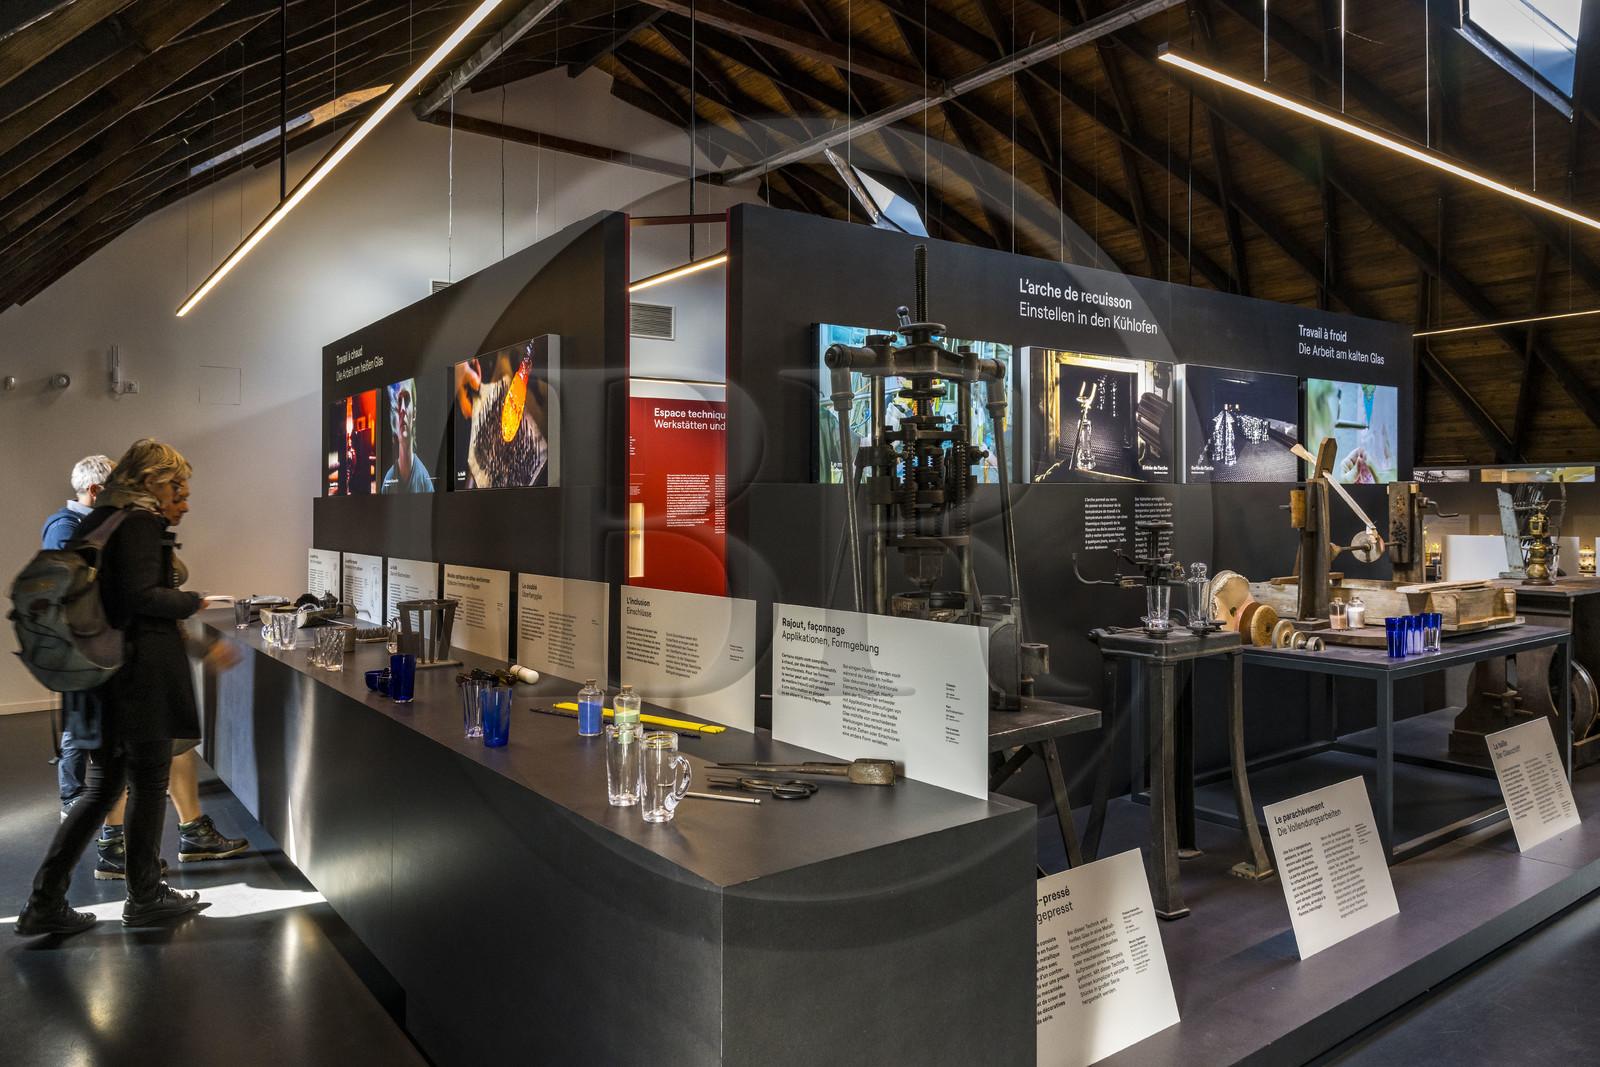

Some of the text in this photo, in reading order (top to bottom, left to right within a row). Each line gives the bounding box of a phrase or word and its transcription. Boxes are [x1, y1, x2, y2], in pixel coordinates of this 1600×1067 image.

[1020, 278, 1132, 310] L'arche de recuisson
[1020, 301, 1158, 334] Einstellen in den Kühlofen
[1298, 324, 1347, 342] Travail à froid
[1298, 342, 1384, 365] Die Arbeit am kalten Glas
[654, 408, 686, 418] Espace
[654, 419, 726, 430] Werkstätten und
[782, 618, 845, 636] Rajout, façonnage
[782, 630, 879, 655] Applikationen, Formgebung
[1274, 801, 1325, 824] Le parachèvement
[1277, 809, 1342, 836] Die Vollendungsarbeiten
[1085, 920, 1099, 929] Technik
